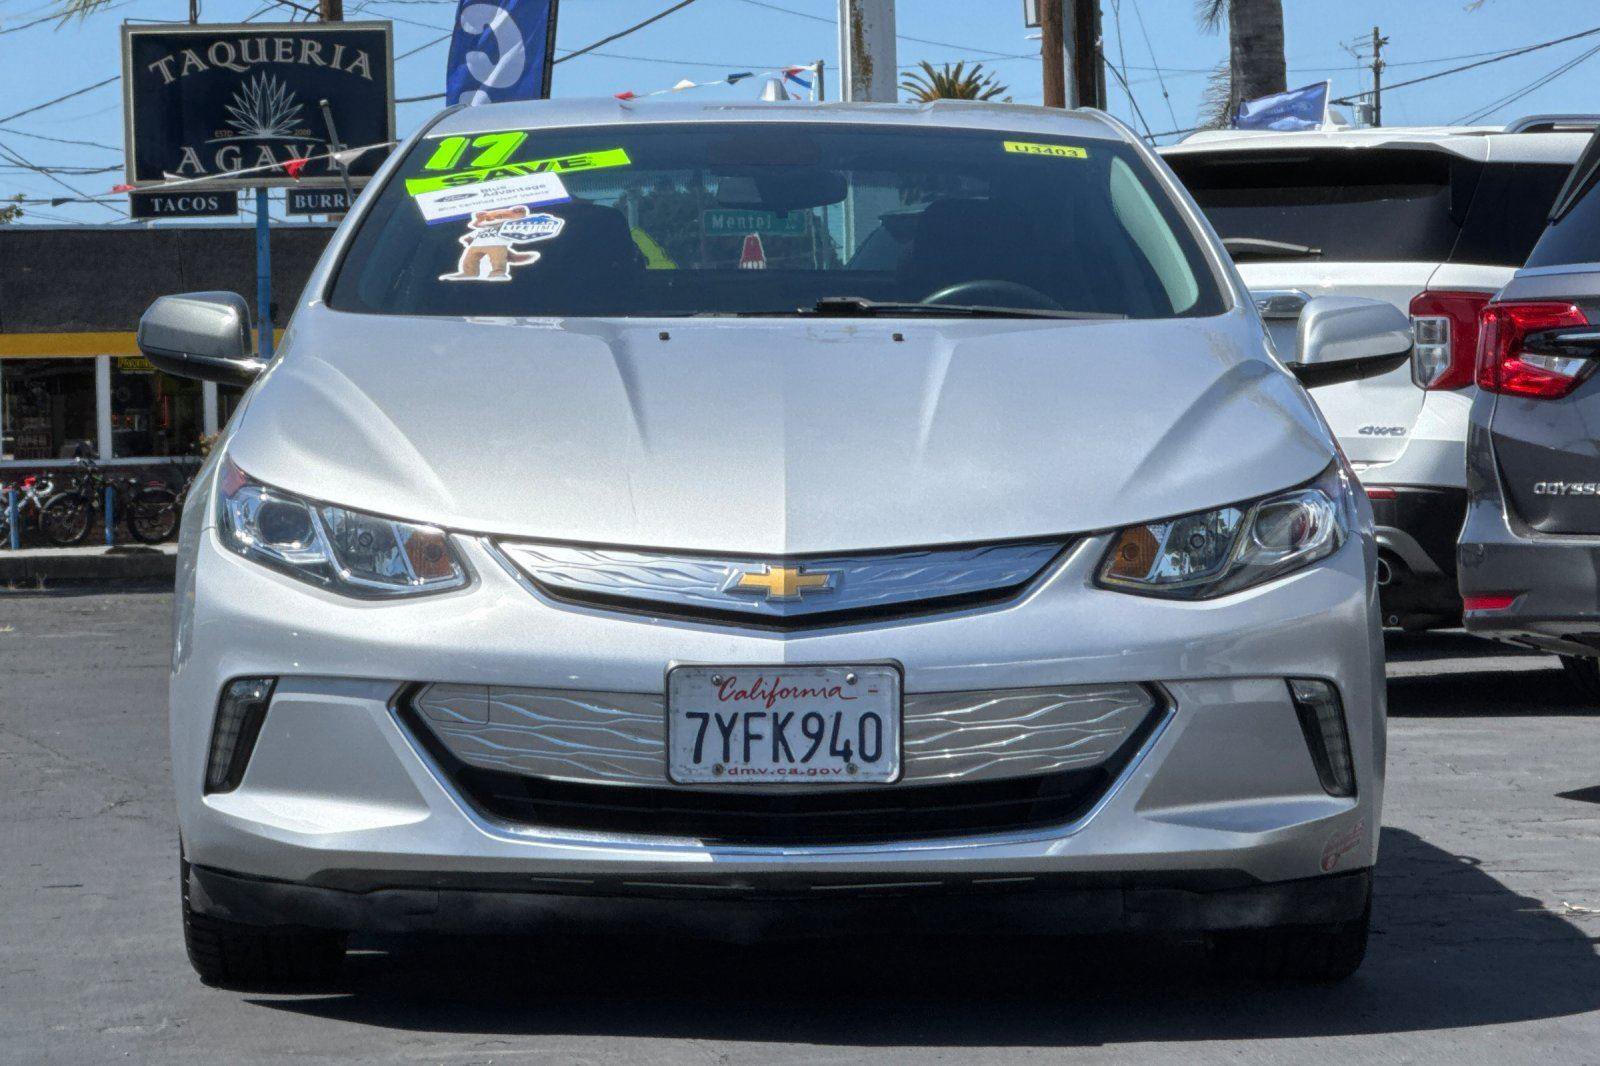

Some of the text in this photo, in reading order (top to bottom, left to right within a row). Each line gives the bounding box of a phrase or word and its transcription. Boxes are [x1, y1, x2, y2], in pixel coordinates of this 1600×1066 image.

[149, 38, 373, 84] TAQUERIA
[176, 144, 350, 175] AGAVE
[424, 131, 528, 170] 17
[1014, 145, 1079, 157] U3403
[441, 155, 593, 187] SAVE
[481, 184, 507, 193] Blue
[482, 184, 547, 198] Advantage
[151, 197, 218, 212] TACOS
[1358, 426, 1407, 436] 4WD
[716, 676, 858, 708] California
[685, 711, 883, 764] 7YFK940
[727, 766, 843, 777] dmv.ca.gov
